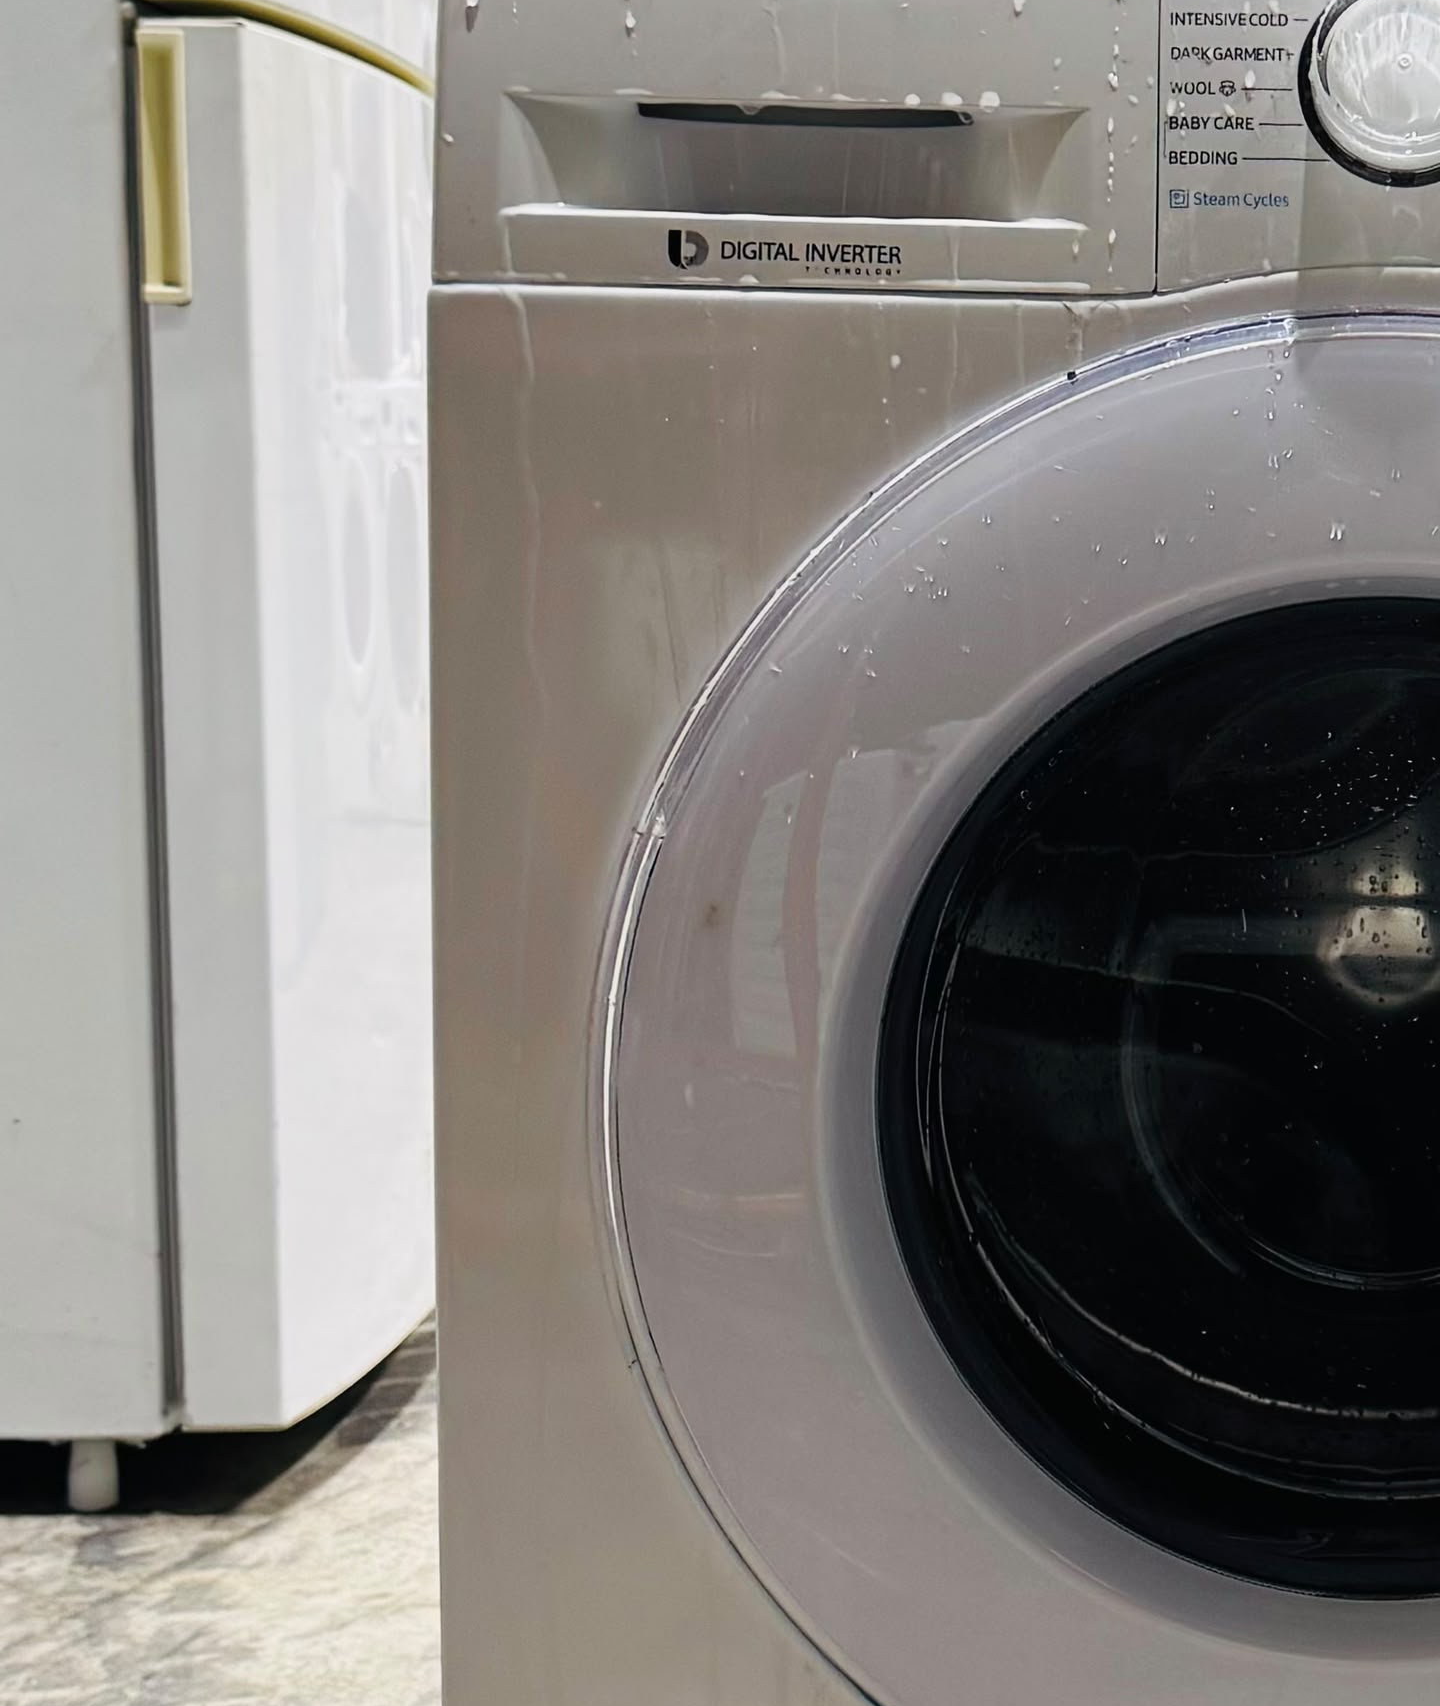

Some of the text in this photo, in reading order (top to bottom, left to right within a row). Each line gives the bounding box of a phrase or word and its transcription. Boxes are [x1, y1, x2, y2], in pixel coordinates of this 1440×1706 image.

[1170, 12, 1289, 26] INTENSIVE COLD
[1171, 47, 1212, 61] DARK
[1170, 81, 1216, 95] WOOL
[1169, 116, 1255, 131] BABY CARE
[1169, 151, 1238, 165] BEDDING
[1193, 192, 1289, 210] Steam Cycles
[721, 241, 902, 264] DIGITAL INVERTER
